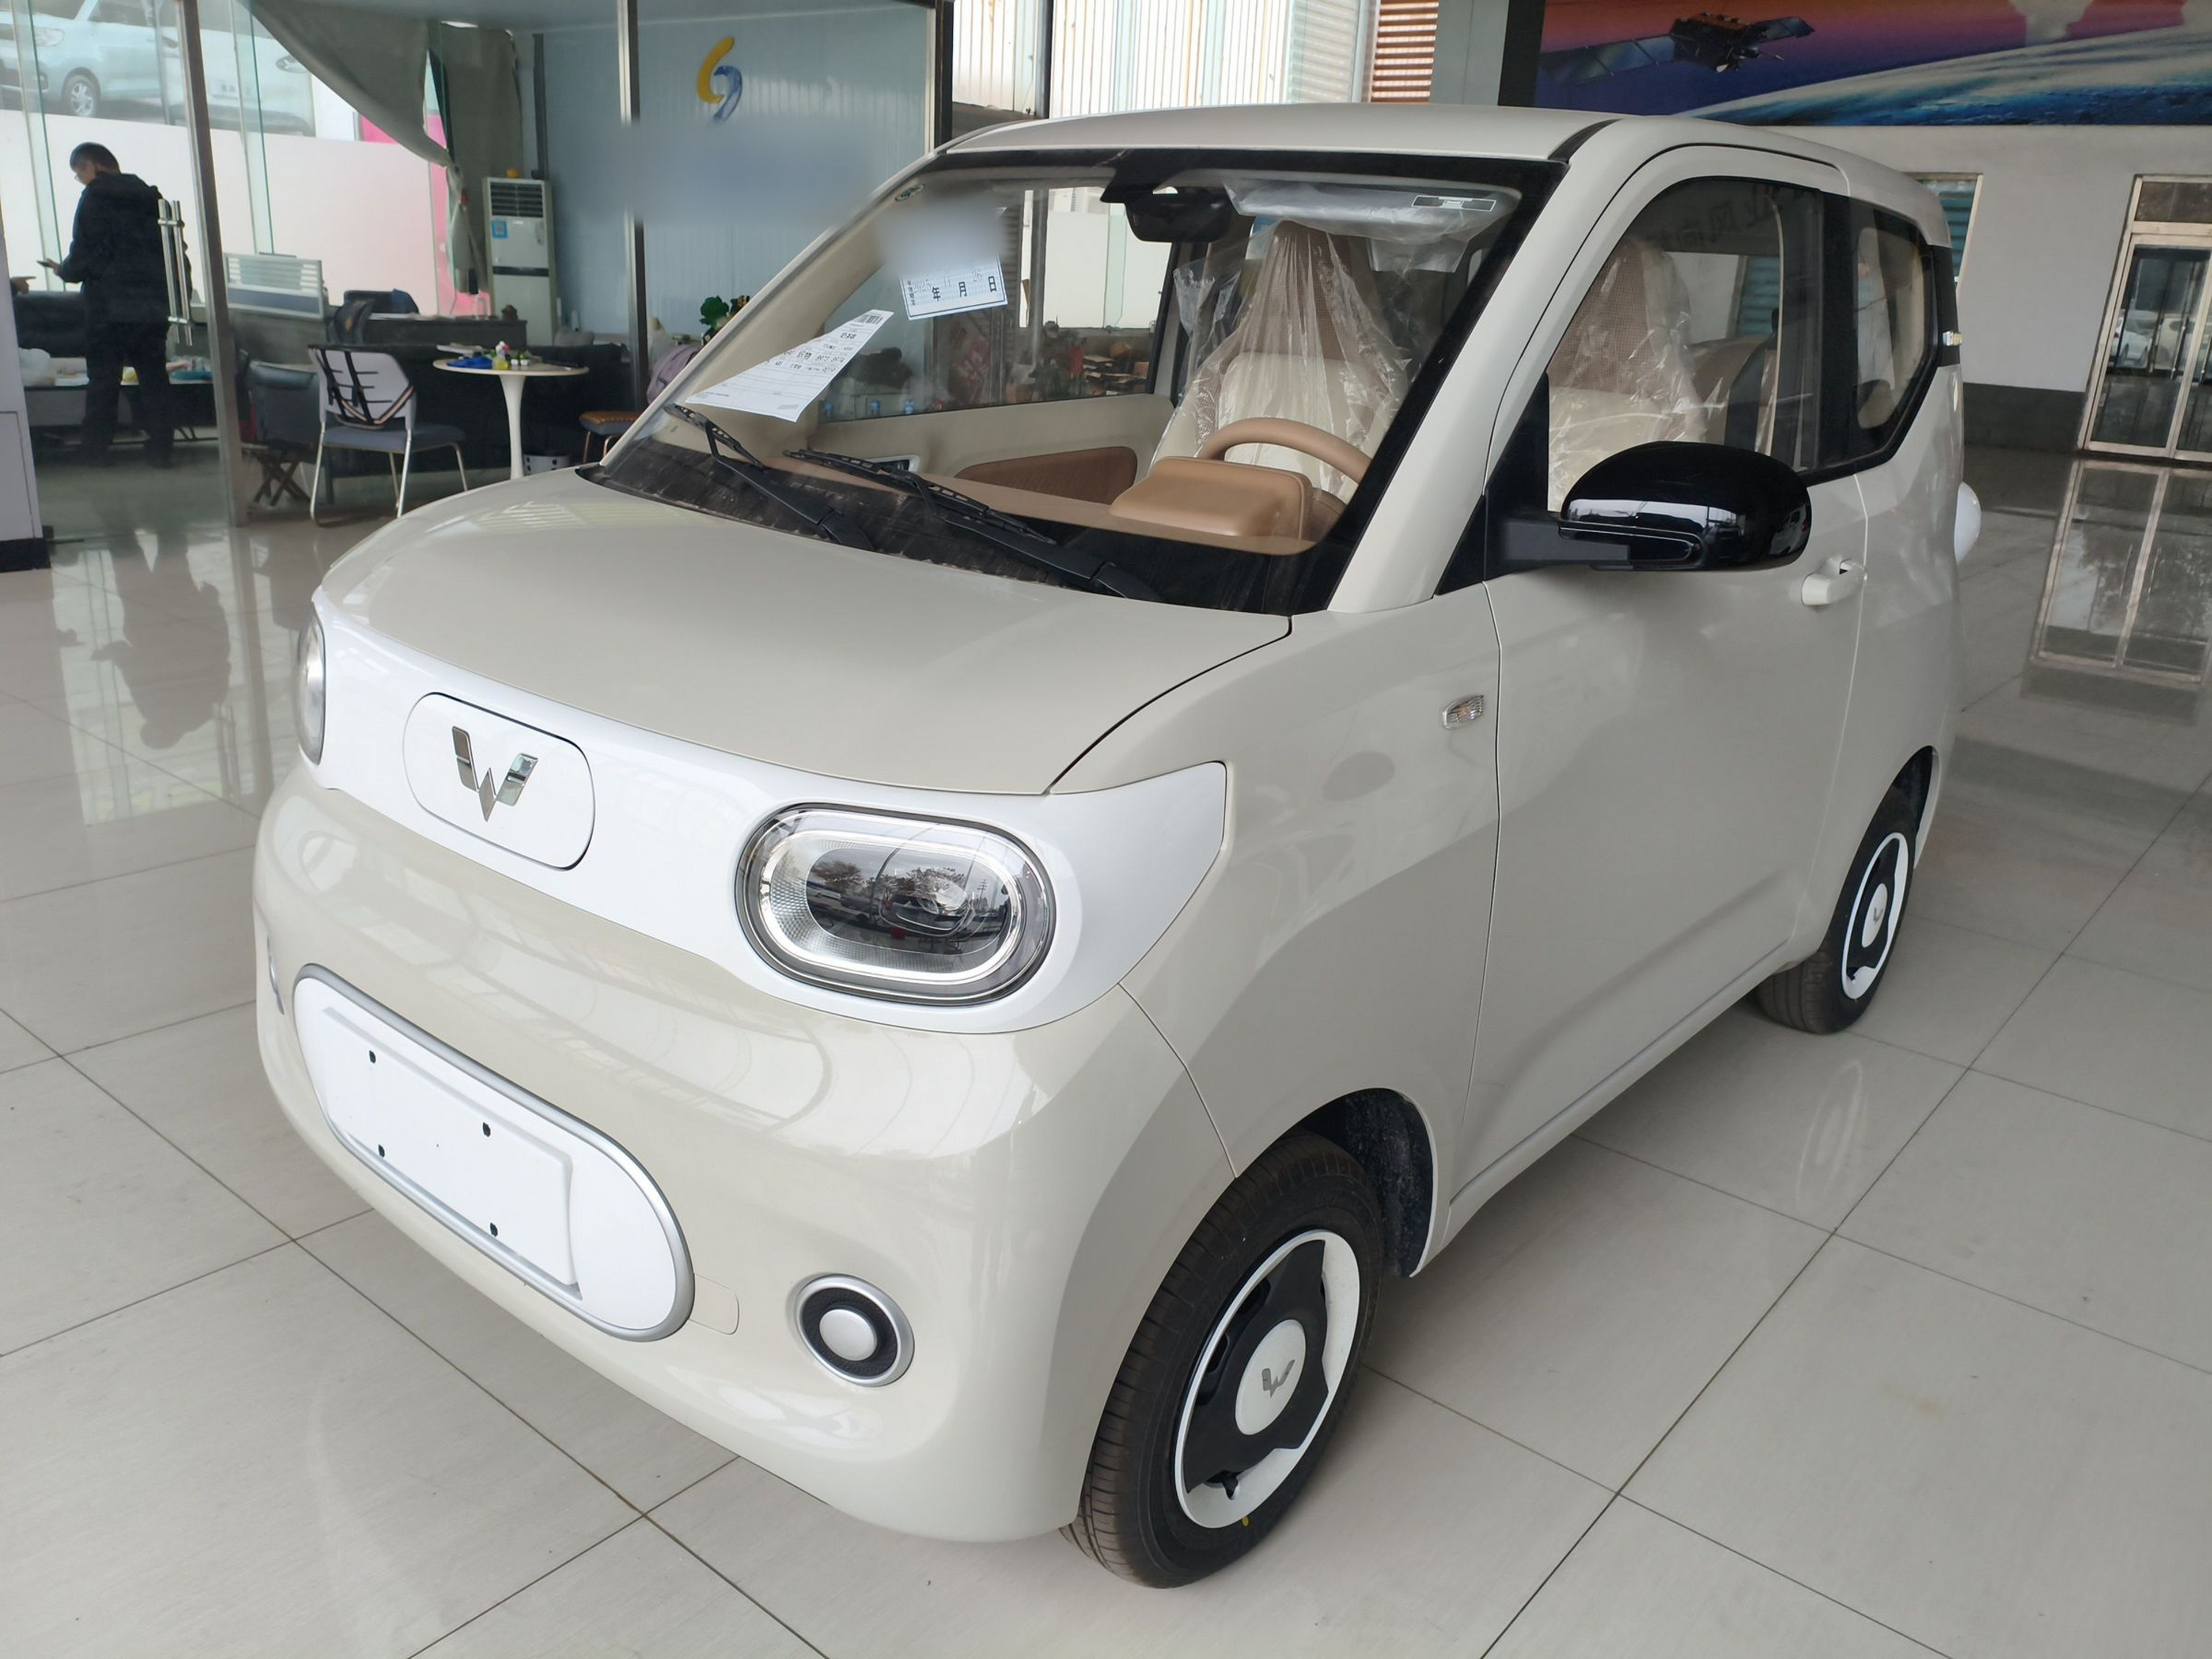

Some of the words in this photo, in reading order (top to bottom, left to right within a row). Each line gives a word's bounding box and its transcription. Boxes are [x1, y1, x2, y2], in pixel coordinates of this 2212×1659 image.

[932, 286, 941, 301] 年
[959, 281, 967, 297] 月
[988, 276, 997, 292] 日
